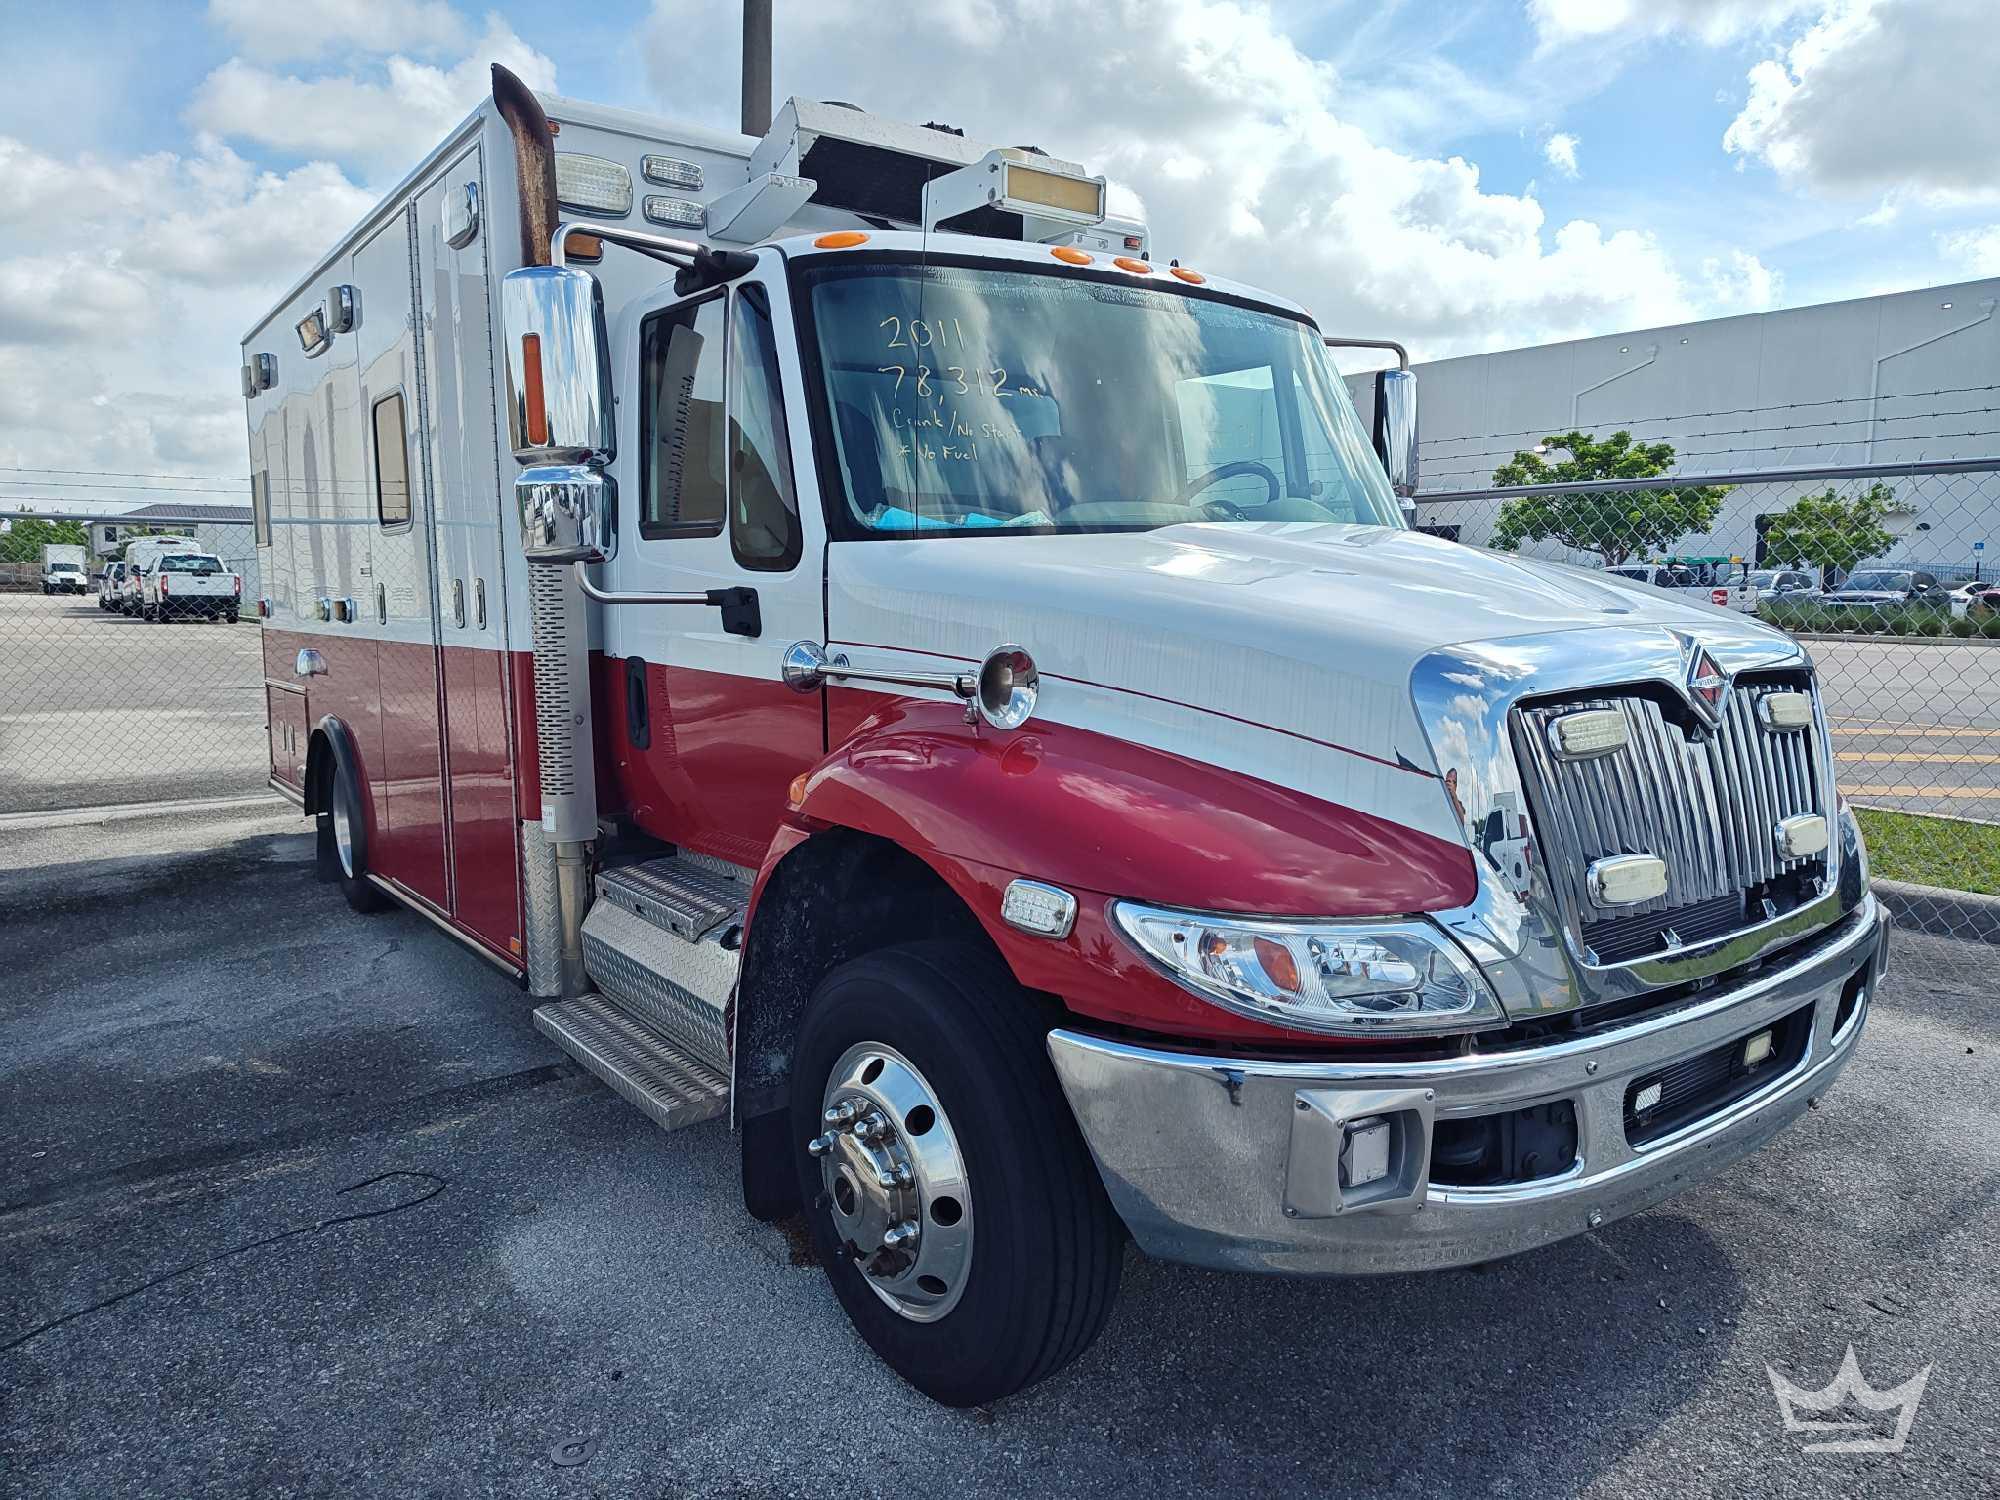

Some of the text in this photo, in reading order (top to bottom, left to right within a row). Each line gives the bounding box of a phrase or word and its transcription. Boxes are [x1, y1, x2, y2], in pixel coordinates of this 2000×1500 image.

[880, 317, 965, 349] 2011
[878, 366, 1012, 406] 78,312
[942, 443, 978, 461] Fuel
